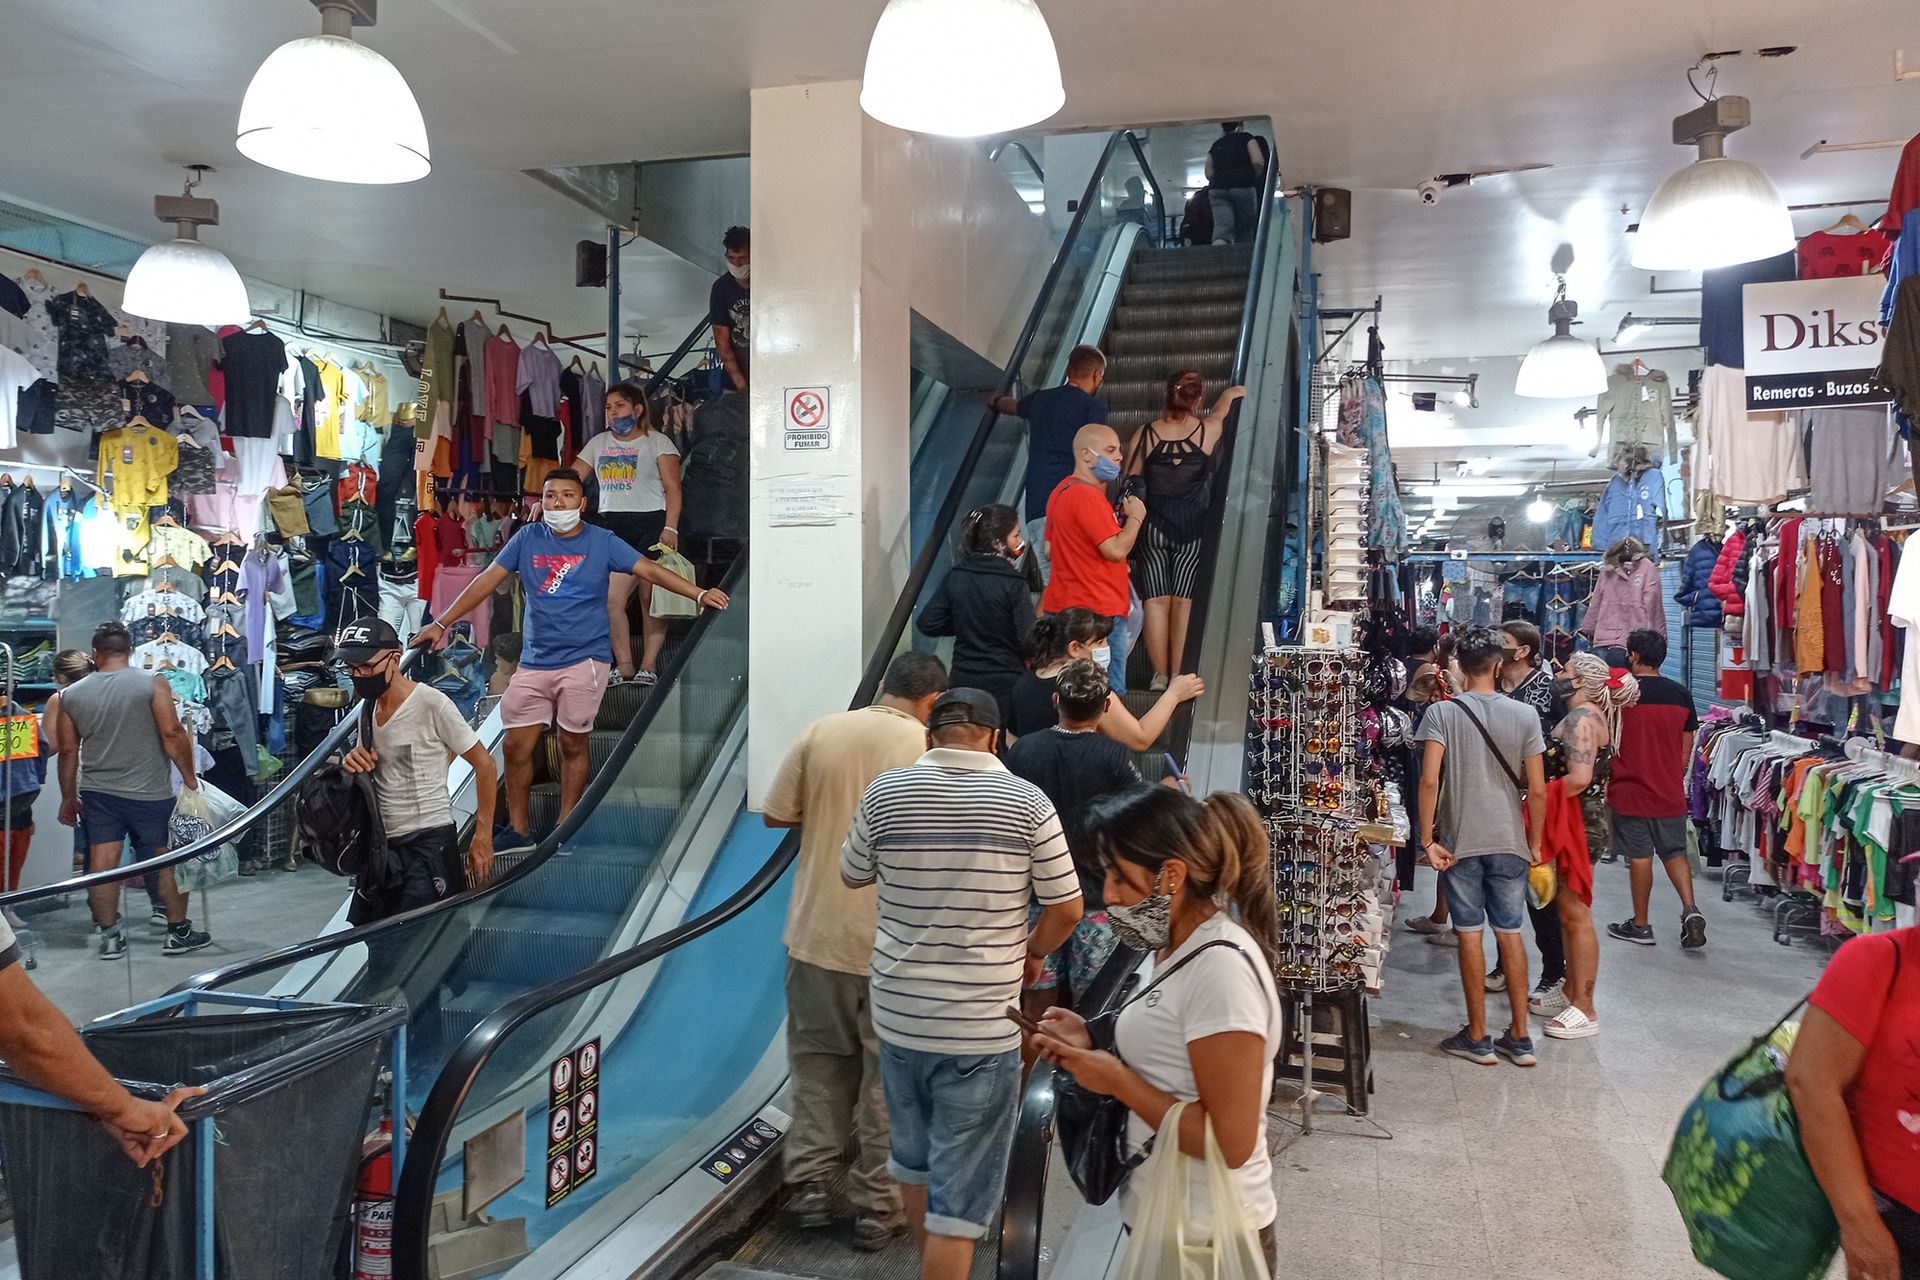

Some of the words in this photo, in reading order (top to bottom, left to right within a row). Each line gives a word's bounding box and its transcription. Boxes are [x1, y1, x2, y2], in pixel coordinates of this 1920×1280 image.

[1760, 309, 1887, 352] Diks
[1753, 386, 1814, 401] Remeras
[1826, 381, 1870, 396] Buzos
[787, 433, 827, 441] PROHIBIDO
[548, 562, 571, 594] adidas
